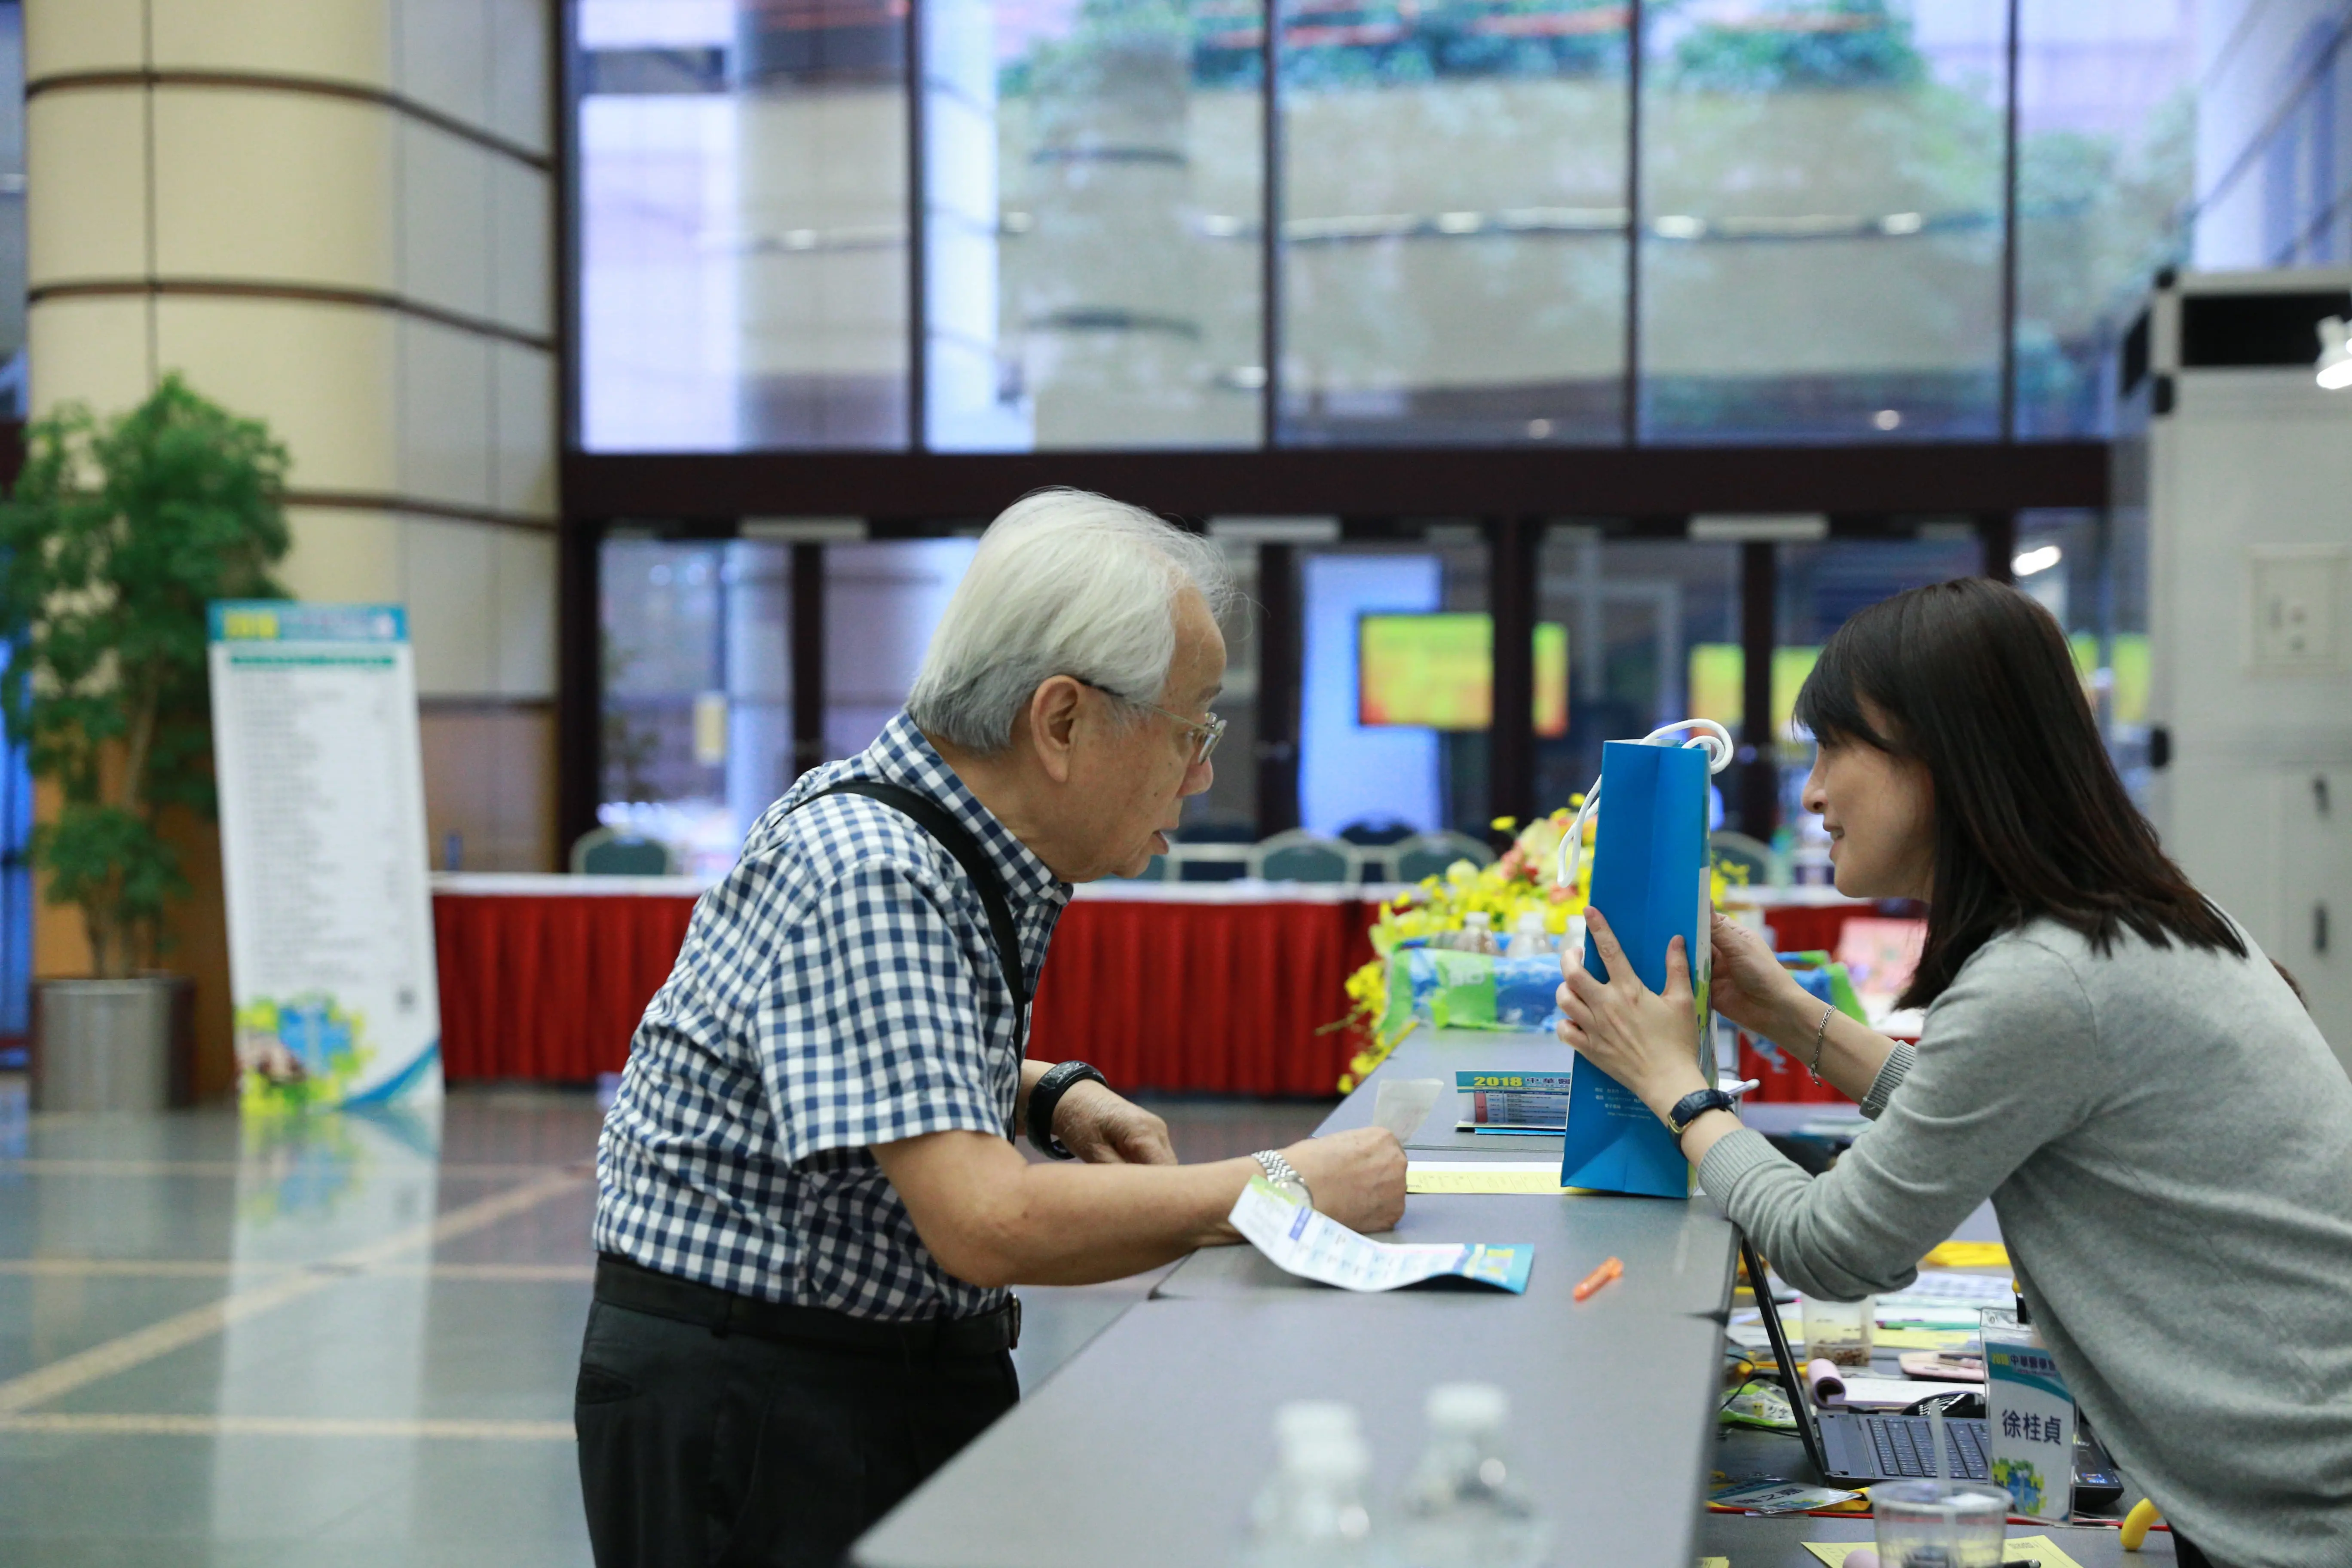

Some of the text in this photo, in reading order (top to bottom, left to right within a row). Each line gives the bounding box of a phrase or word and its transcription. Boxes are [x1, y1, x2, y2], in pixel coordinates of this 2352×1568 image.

[1473, 1077, 1522, 1086] 2018
[2002, 1409, 2061, 1446] 徐桂貞
